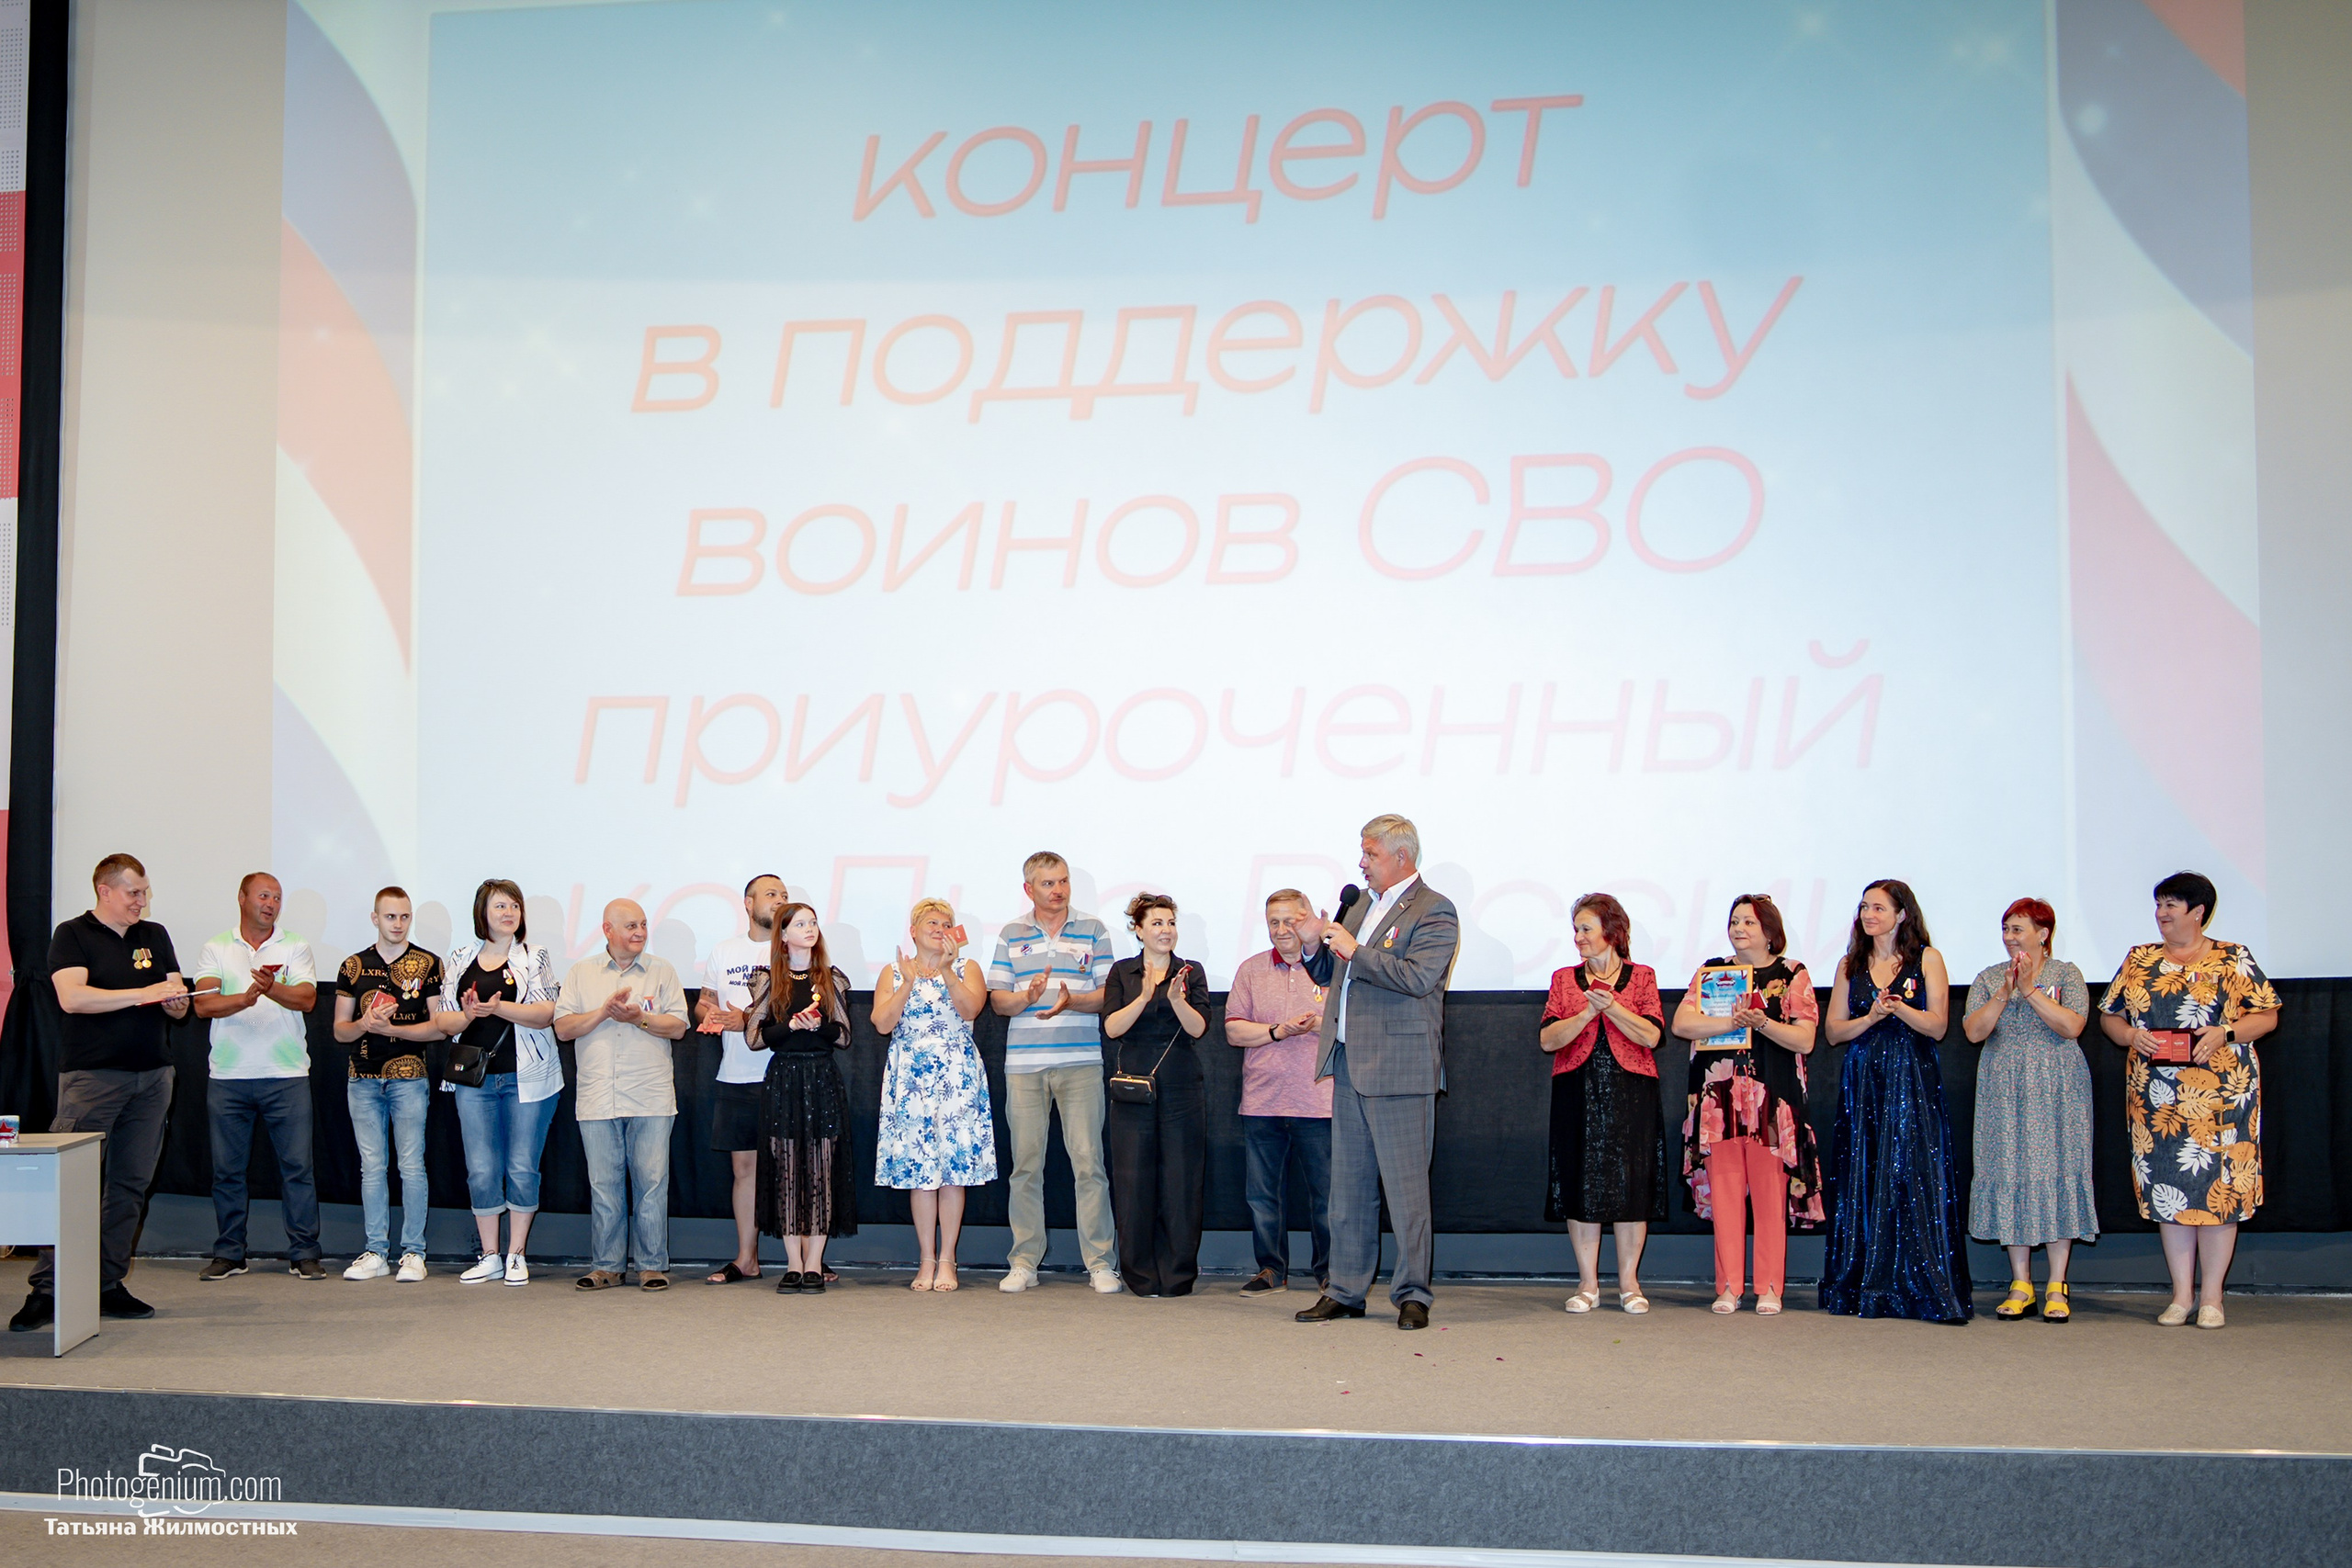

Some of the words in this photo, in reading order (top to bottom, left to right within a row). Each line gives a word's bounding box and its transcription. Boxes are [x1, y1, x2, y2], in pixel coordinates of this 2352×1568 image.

[852, 94, 1585, 224] концерт
[630, 323, 723, 413] в
[769, 276, 1804, 424] поддержку
[675, 491, 1301, 597] воинов
[1357, 446, 1766, 581] СВО
[574, 638, 1885, 809] приуроченный
